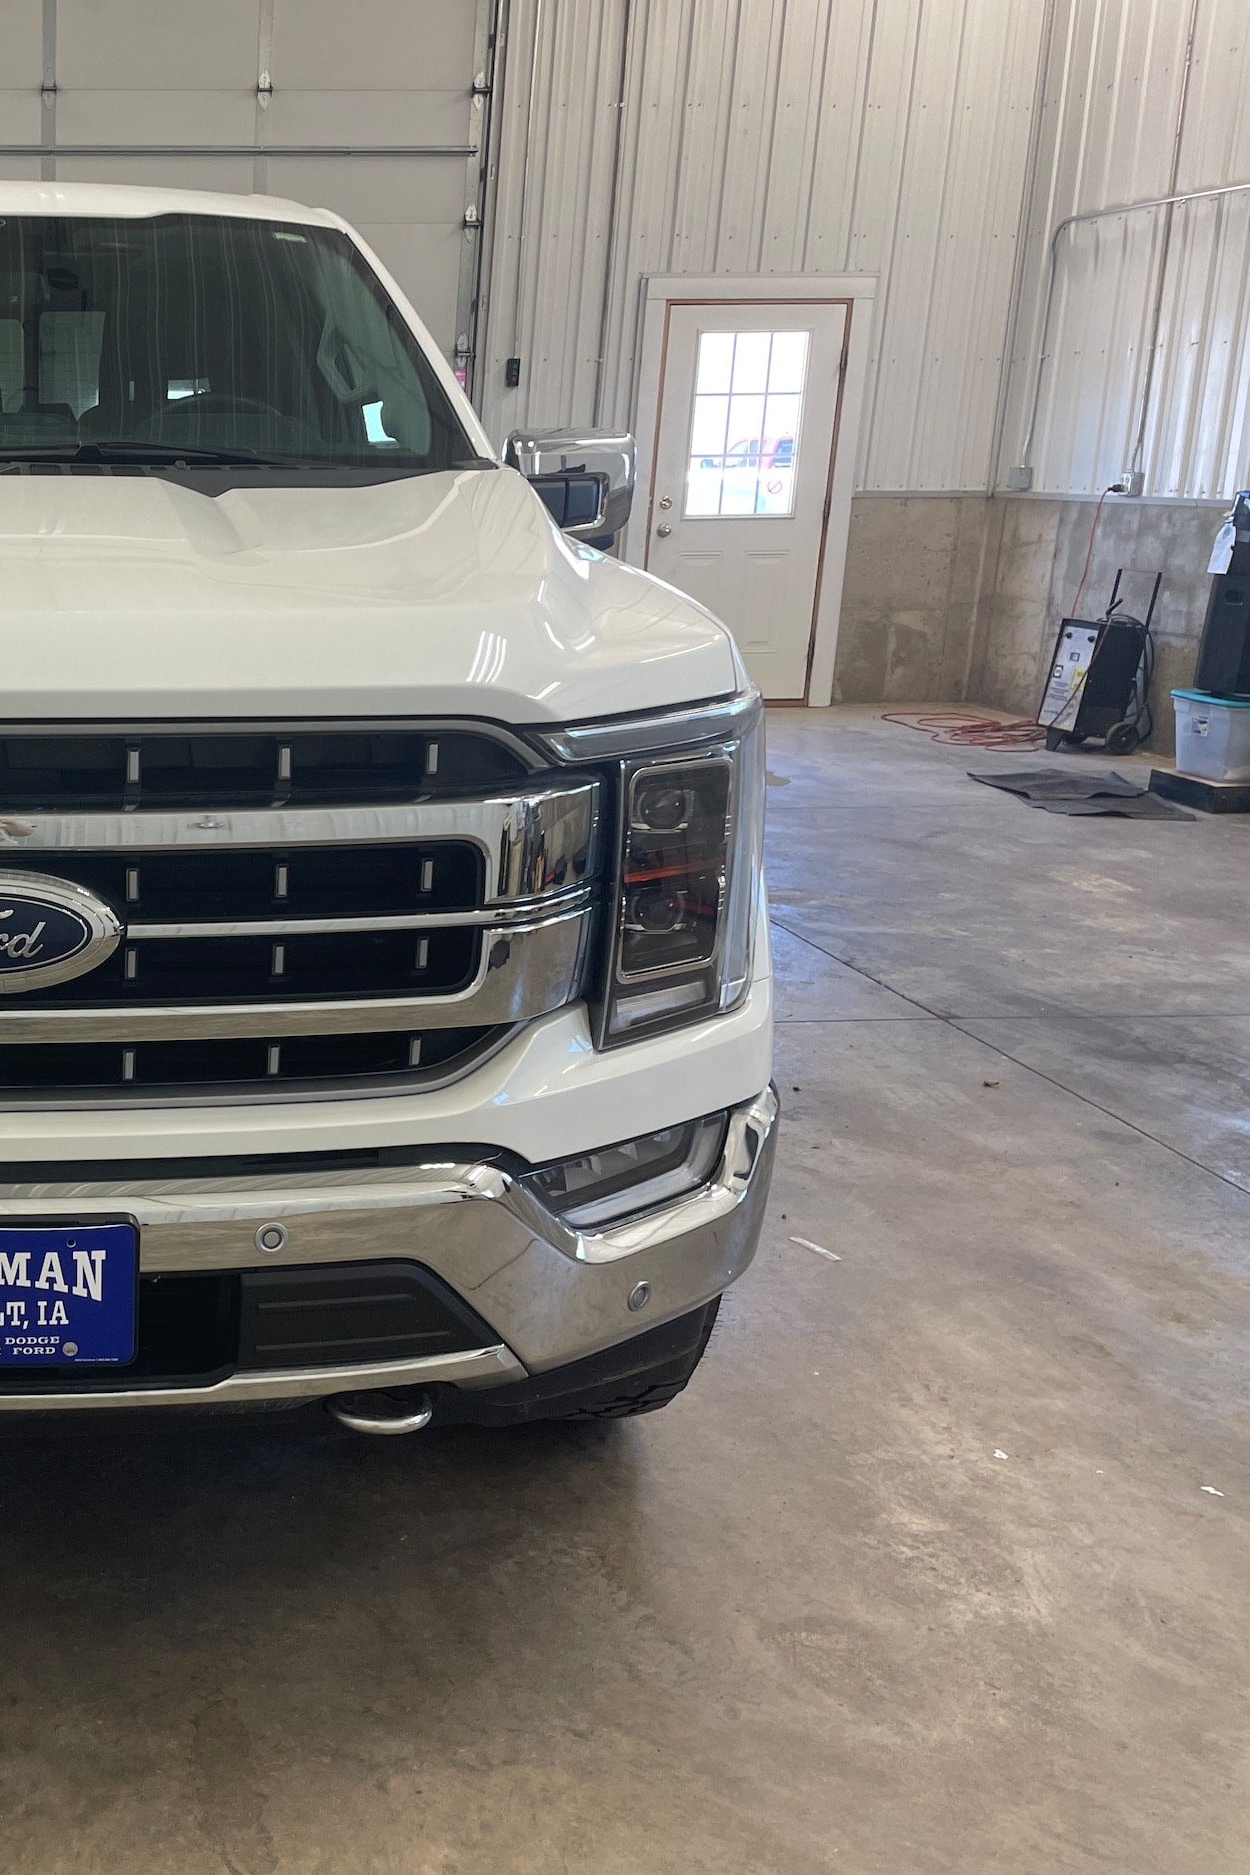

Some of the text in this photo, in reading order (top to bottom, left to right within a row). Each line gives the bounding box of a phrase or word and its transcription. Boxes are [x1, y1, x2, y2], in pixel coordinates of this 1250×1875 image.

[37, 1300, 70, 1326] IA
[4, 1335, 61, 1346] DODGE
[12, 1346, 56, 1356] FORD
